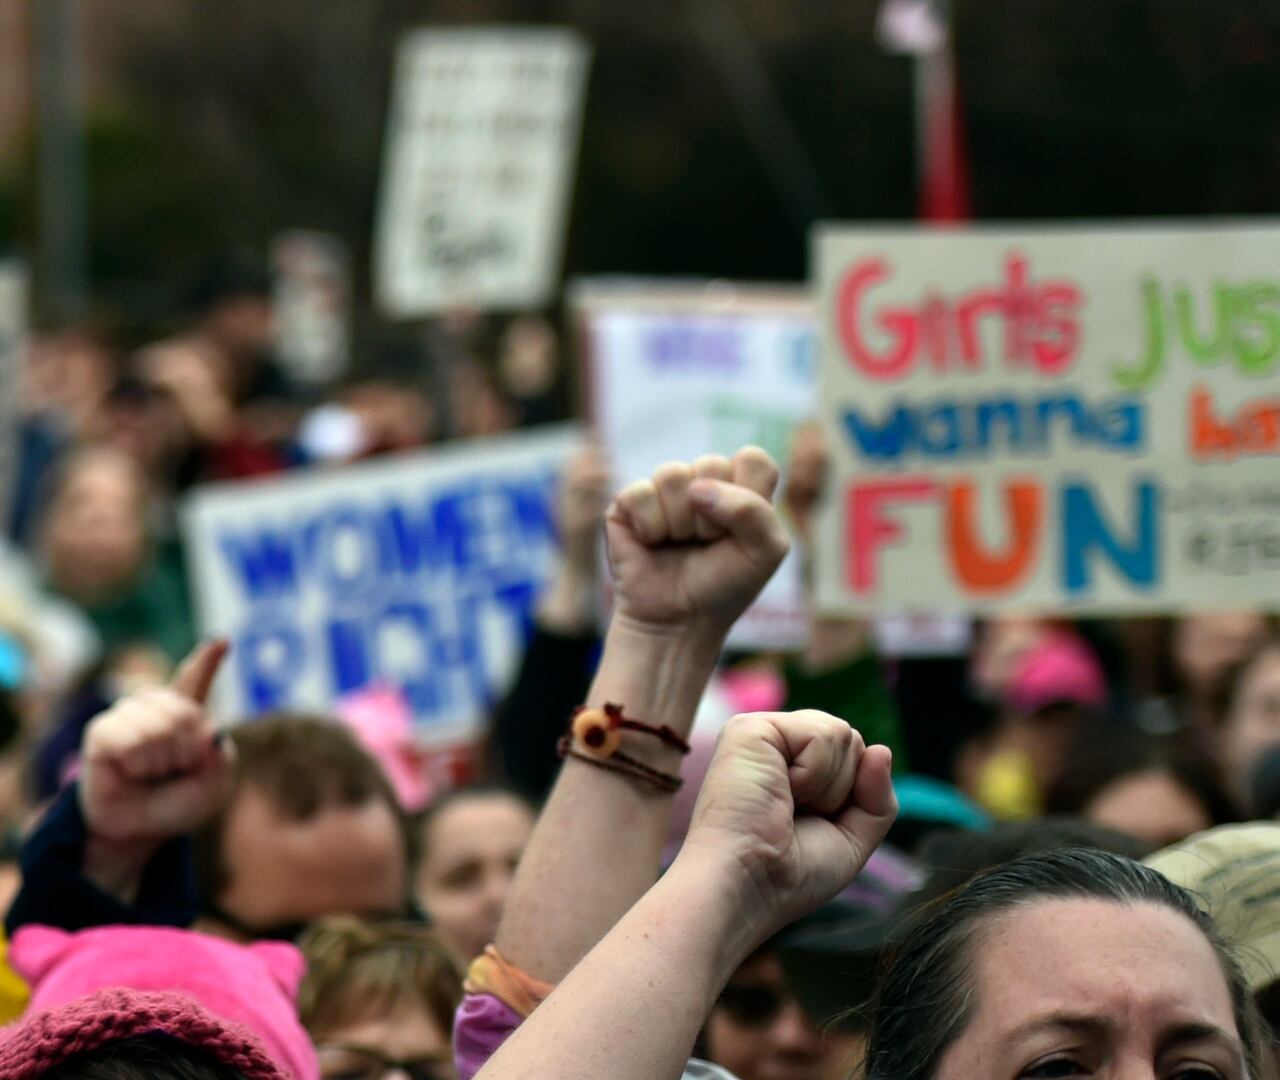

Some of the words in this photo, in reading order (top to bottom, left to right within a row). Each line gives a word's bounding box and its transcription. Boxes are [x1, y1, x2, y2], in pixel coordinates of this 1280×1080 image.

[836, 252, 1085, 380] Girls
[844, 394, 1145, 463] wanna
[846, 477, 1162, 595] FUN
